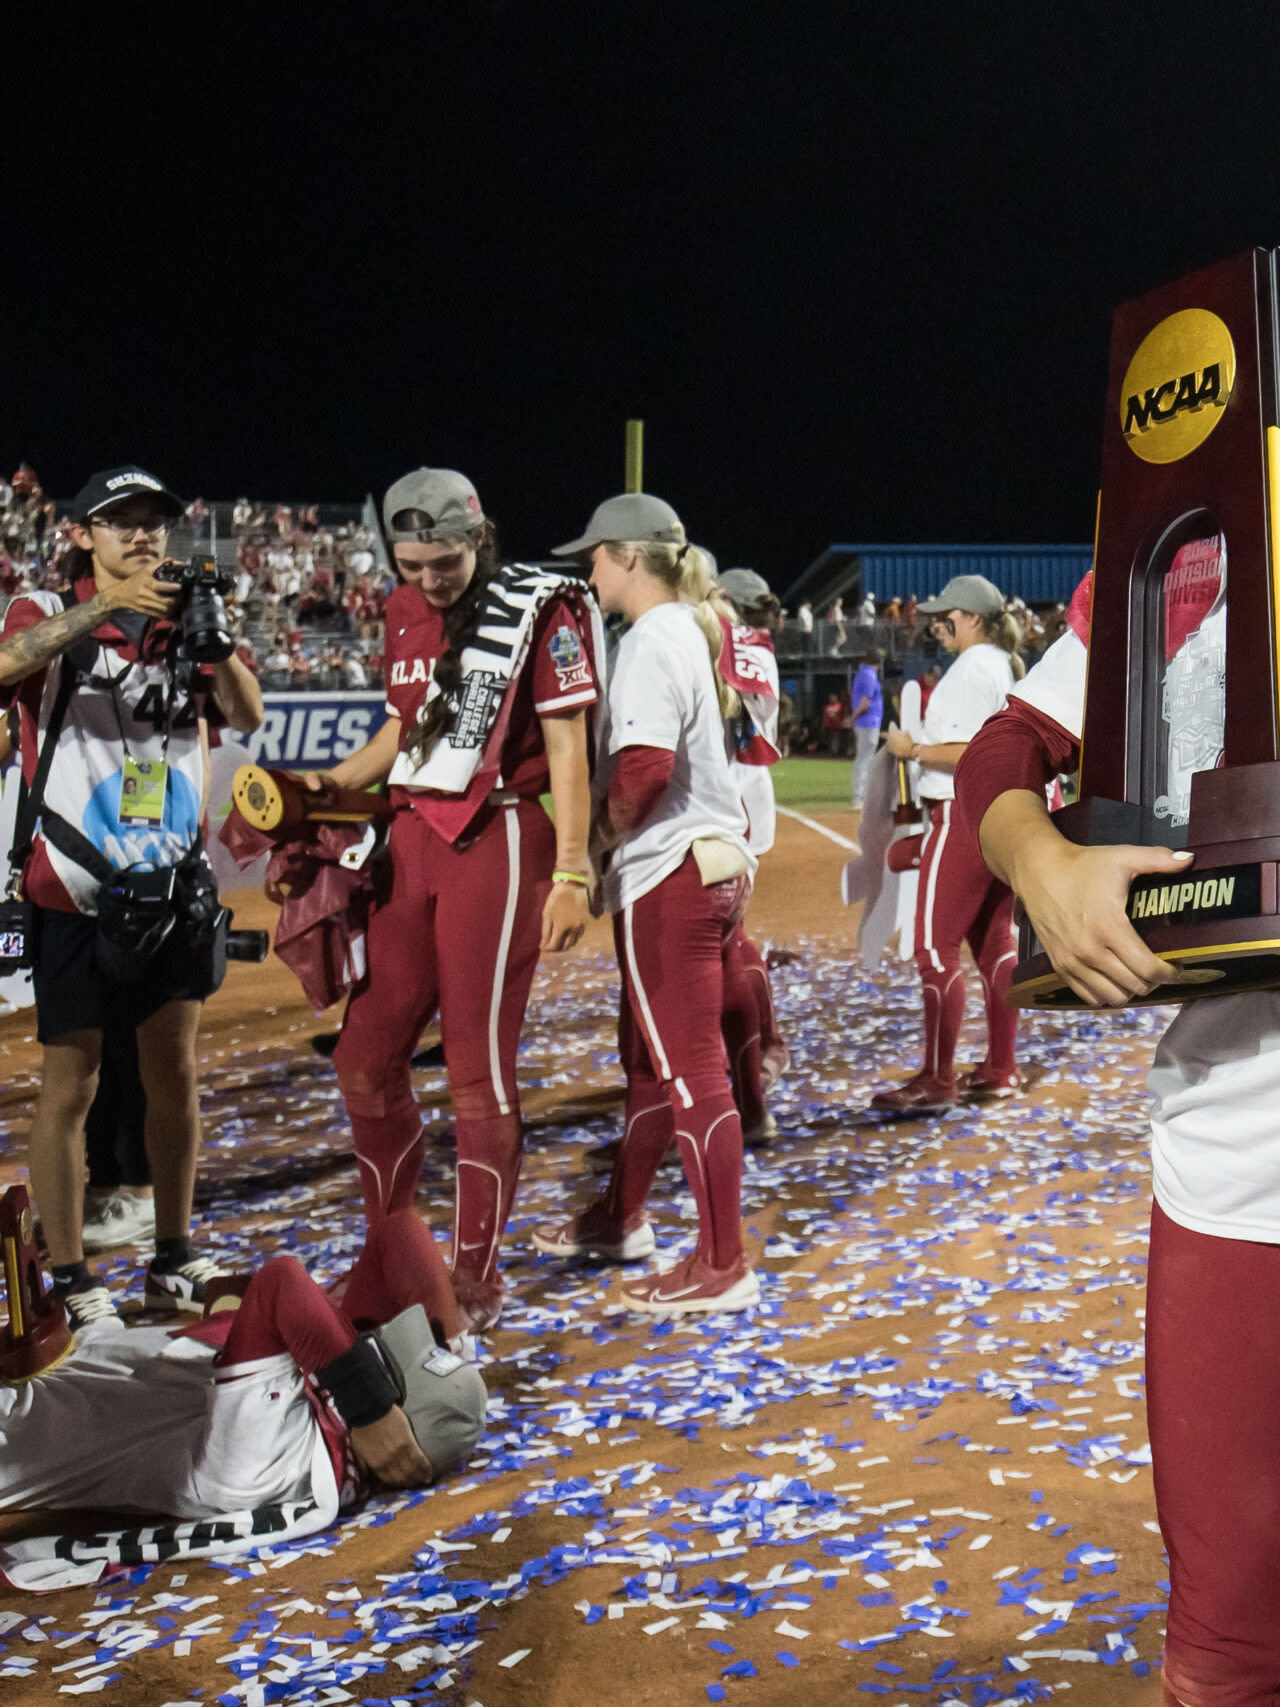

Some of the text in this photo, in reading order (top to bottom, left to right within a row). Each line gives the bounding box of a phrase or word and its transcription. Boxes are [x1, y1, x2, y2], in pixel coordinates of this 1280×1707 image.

[1123, 362, 1224, 437] NCAA
[219, 708, 372, 761] RIES
[1131, 876, 1236, 920] HAMPION
